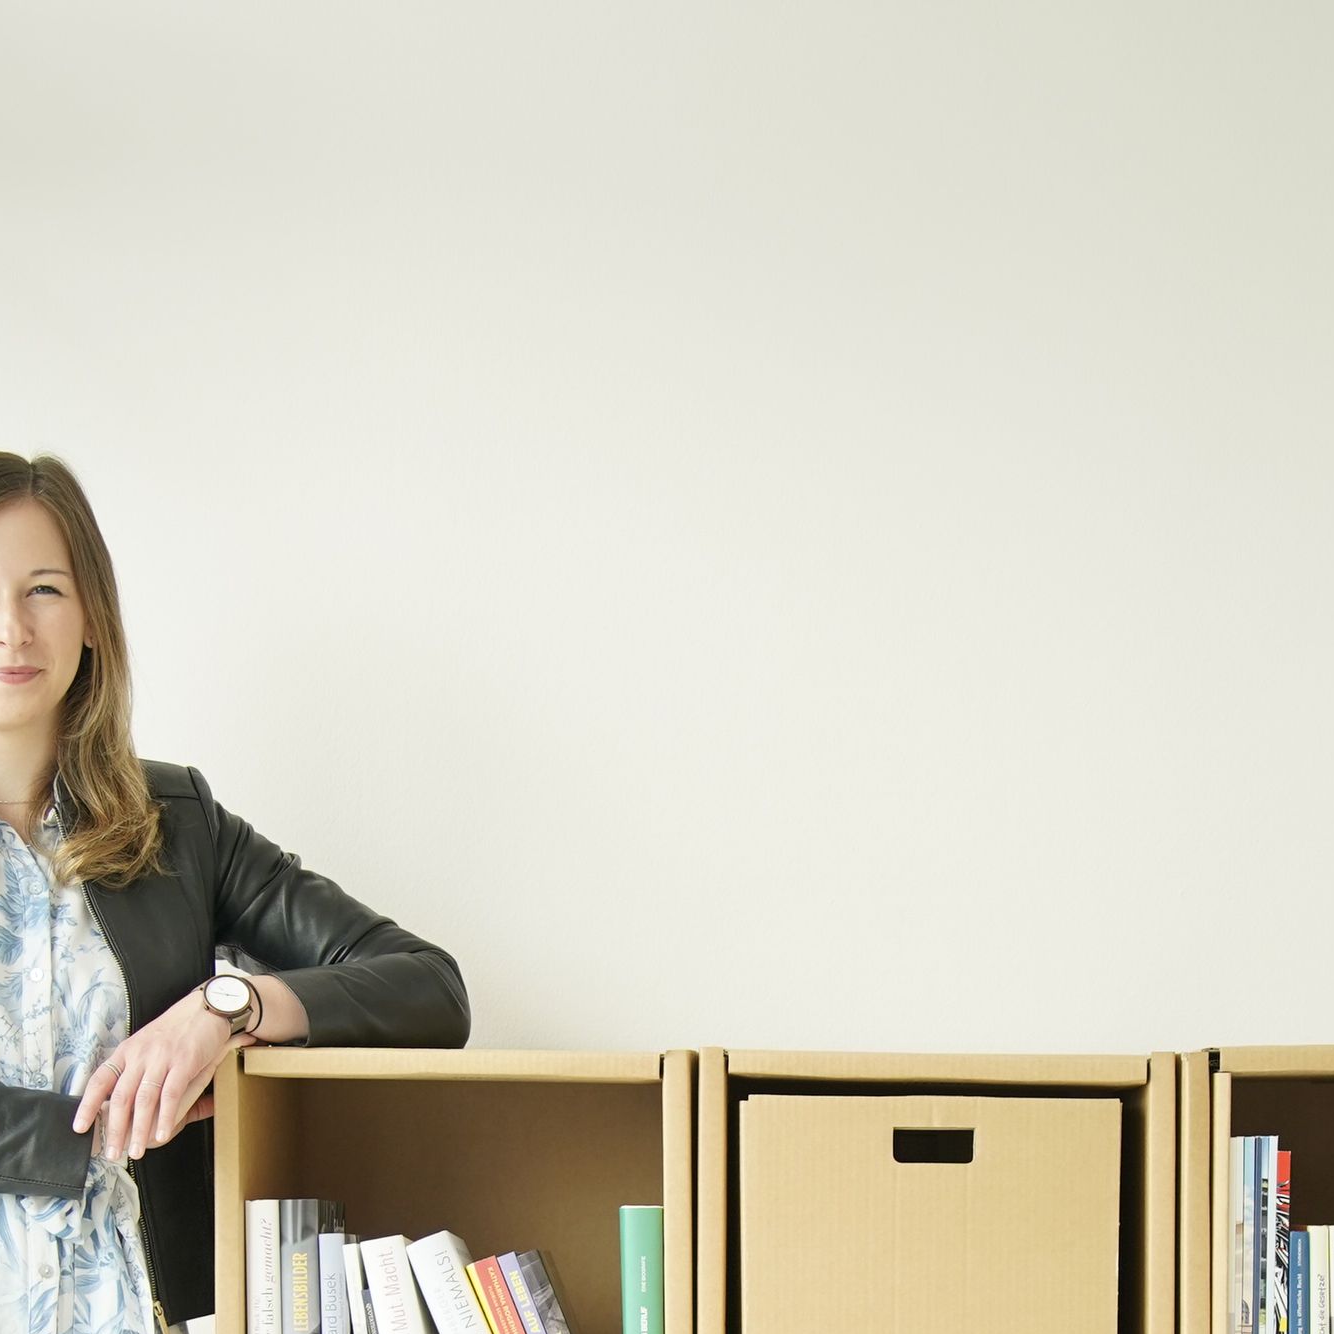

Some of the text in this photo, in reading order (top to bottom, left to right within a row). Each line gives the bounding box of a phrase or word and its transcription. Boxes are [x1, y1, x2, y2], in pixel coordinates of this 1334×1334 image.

[258, 1217, 276, 1284] gemacht?
[377, 1246, 401, 1297] Macht.
[260, 1287, 274, 1326] falsch
[292, 1252, 309, 1332] LEBENSBILDER
[322, 1273, 337, 1313] Busek
[389, 1299, 408, 1332] Mut.
[434, 1251, 478, 1329] NIEMALS!
